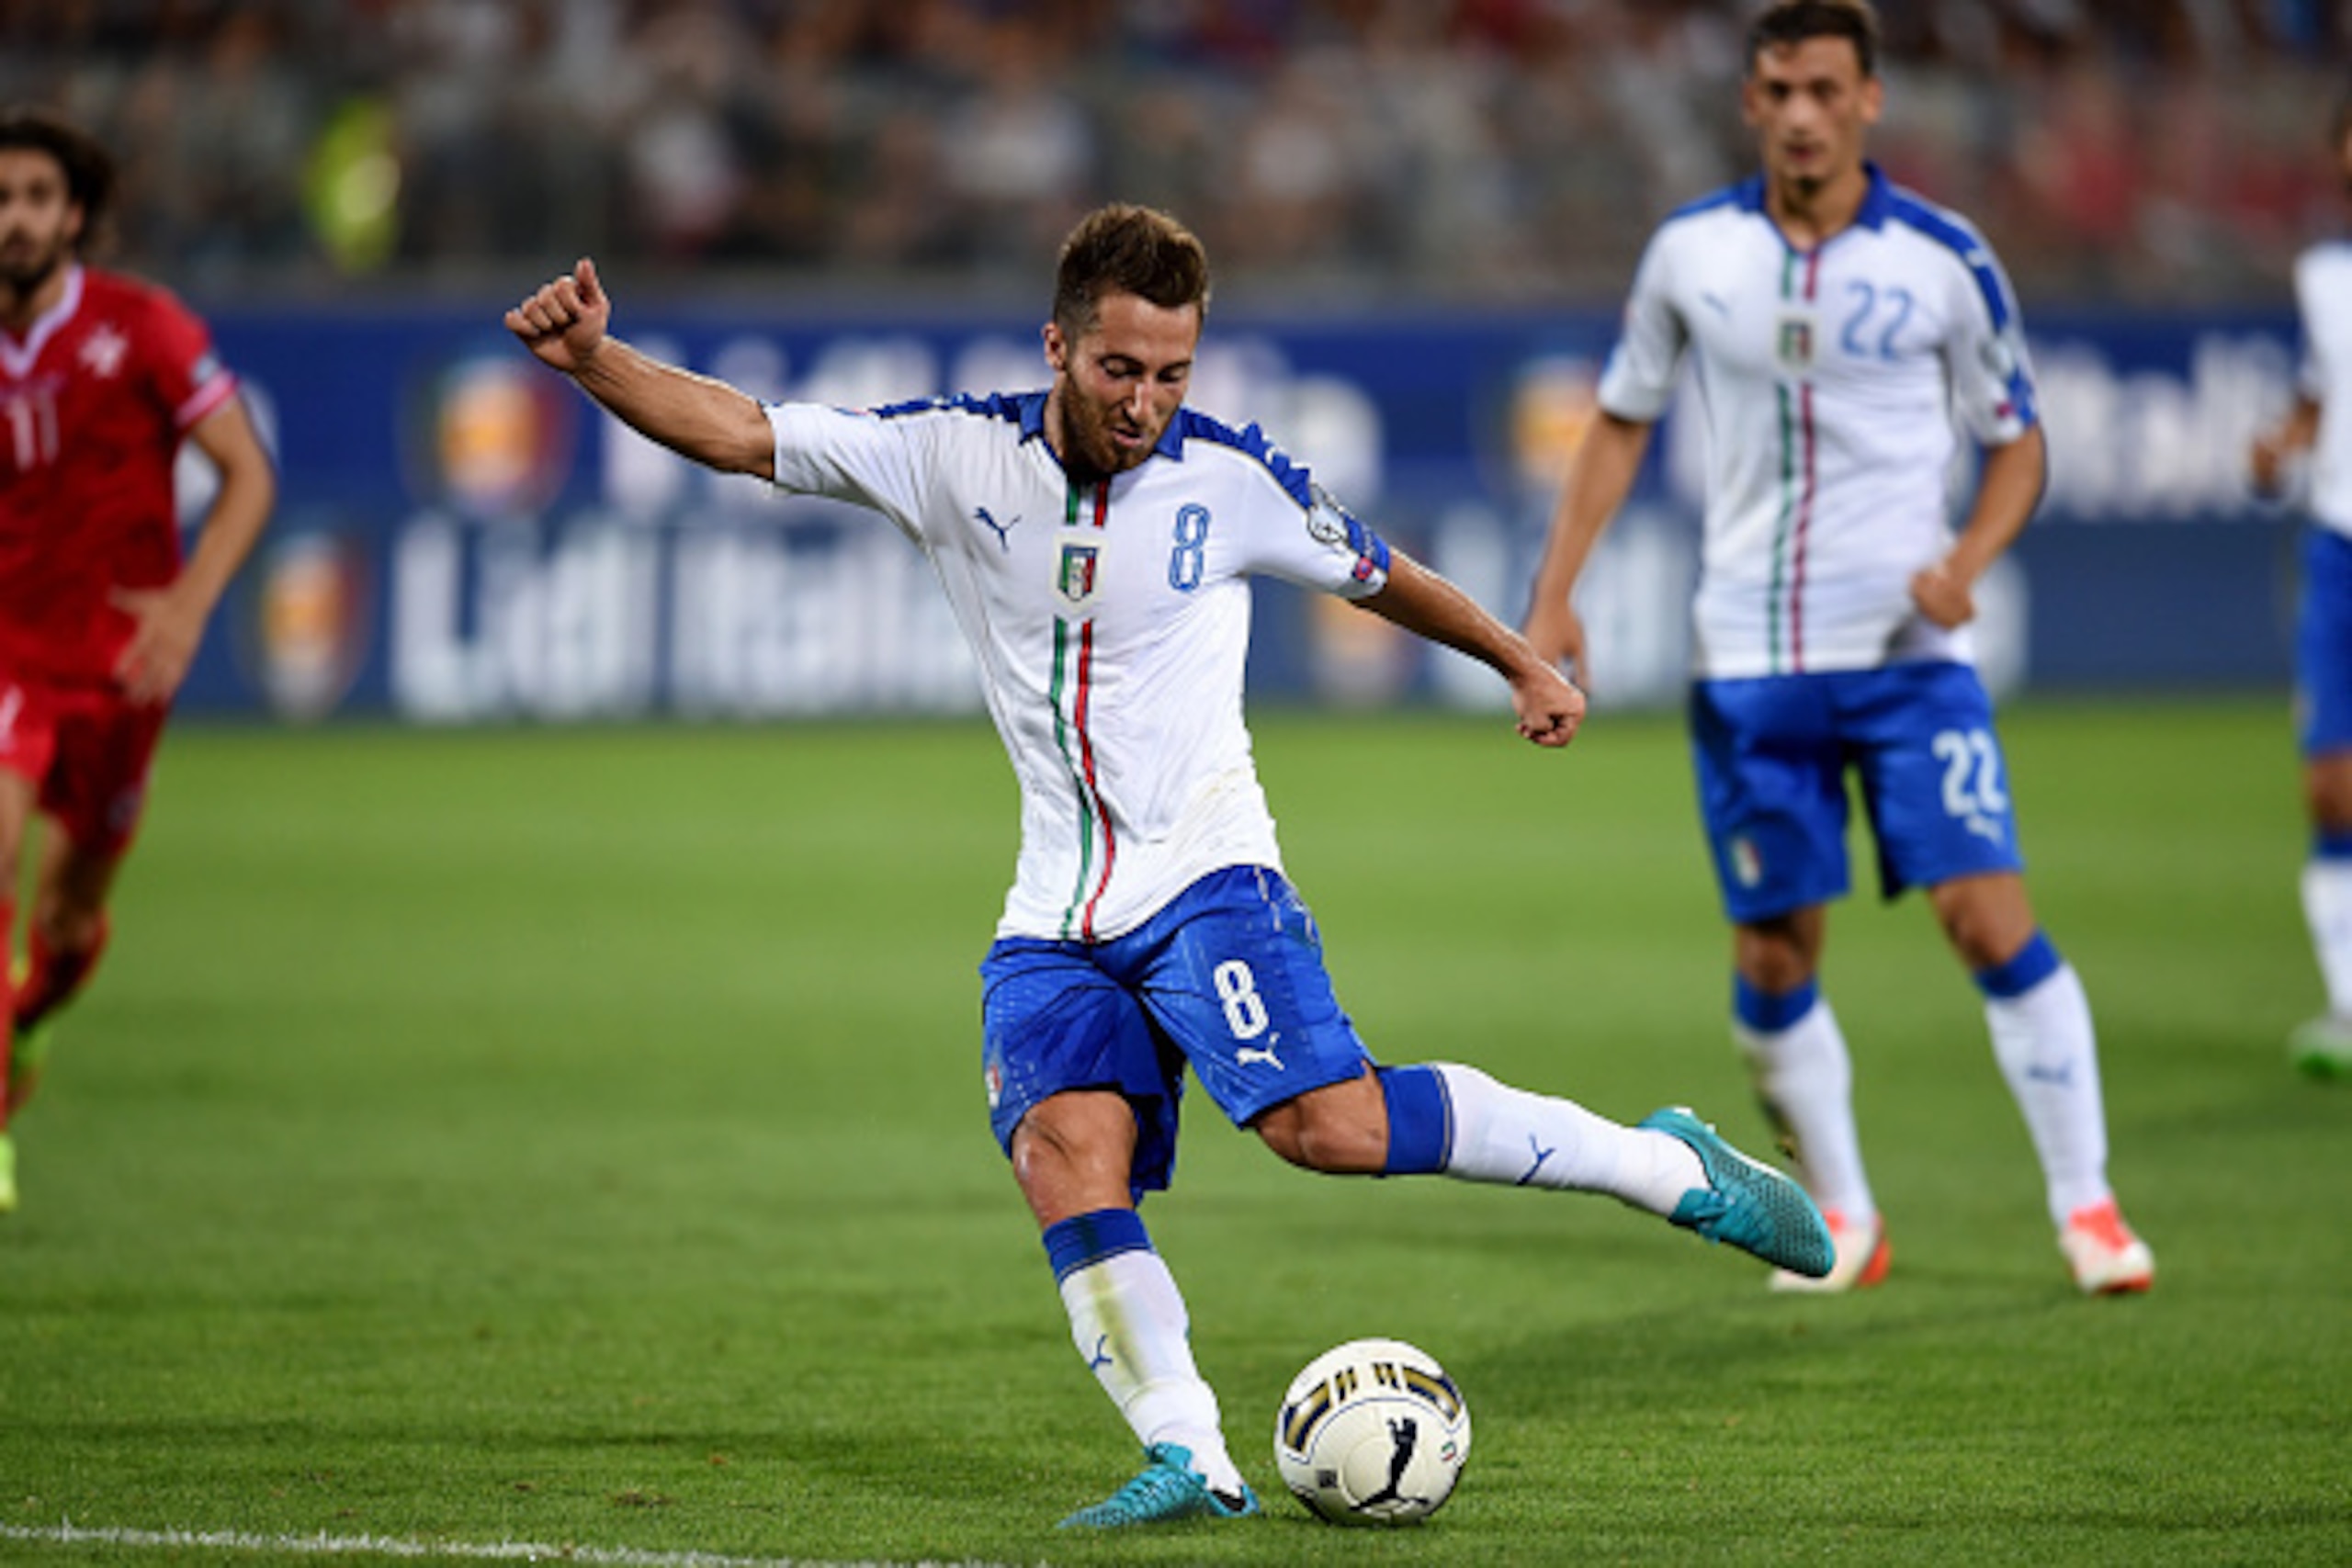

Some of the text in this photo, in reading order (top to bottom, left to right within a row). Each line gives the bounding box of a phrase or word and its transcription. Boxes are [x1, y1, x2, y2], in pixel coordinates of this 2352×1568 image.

[1839, 277, 1915, 362] 22
[1169, 503, 1210, 592] 8
[1932, 730, 2008, 818] 22
[1214, 960, 1269, 1039] 8
